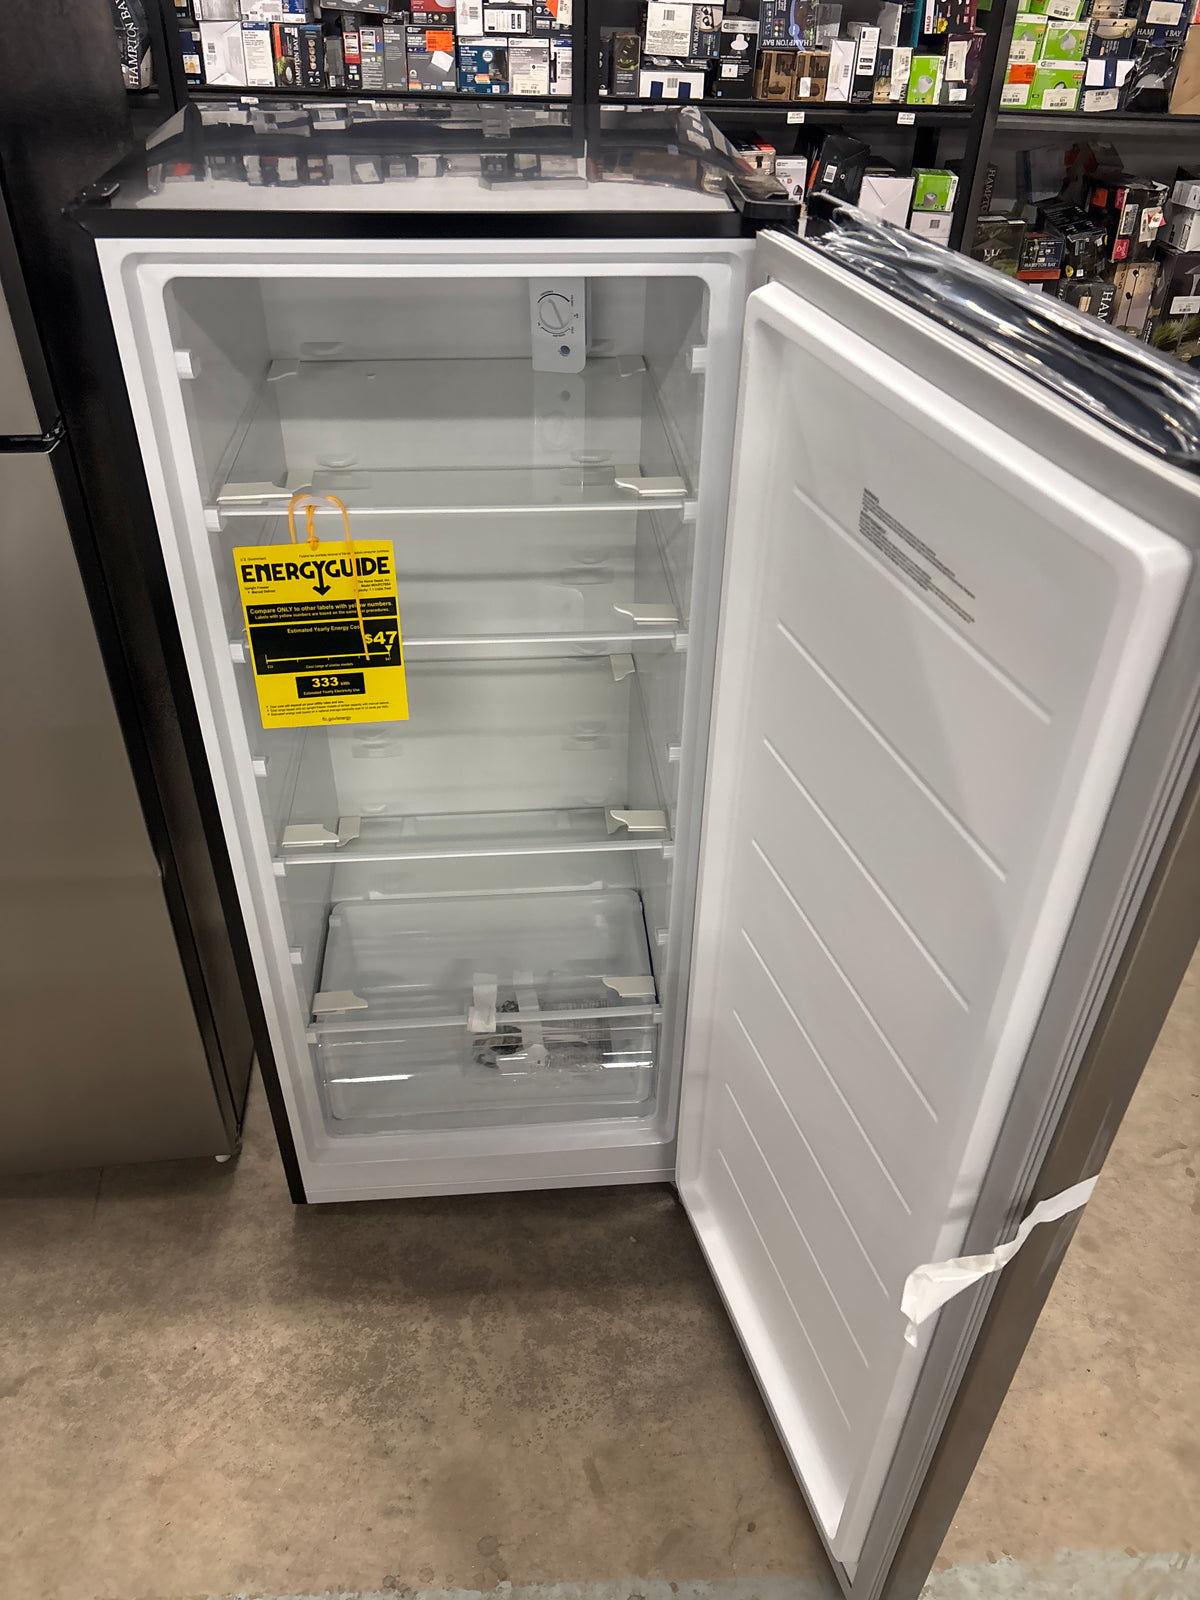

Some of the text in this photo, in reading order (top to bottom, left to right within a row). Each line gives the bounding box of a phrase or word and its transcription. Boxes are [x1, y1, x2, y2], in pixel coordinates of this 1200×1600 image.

[125, 22, 139, 85] HAMPTON
[293, 52, 302, 86] HAMPTON
[241, 556, 390, 583] ENERGYGUIDE
[364, 631, 398, 645] $47
[312, 677, 339, 688] 333
